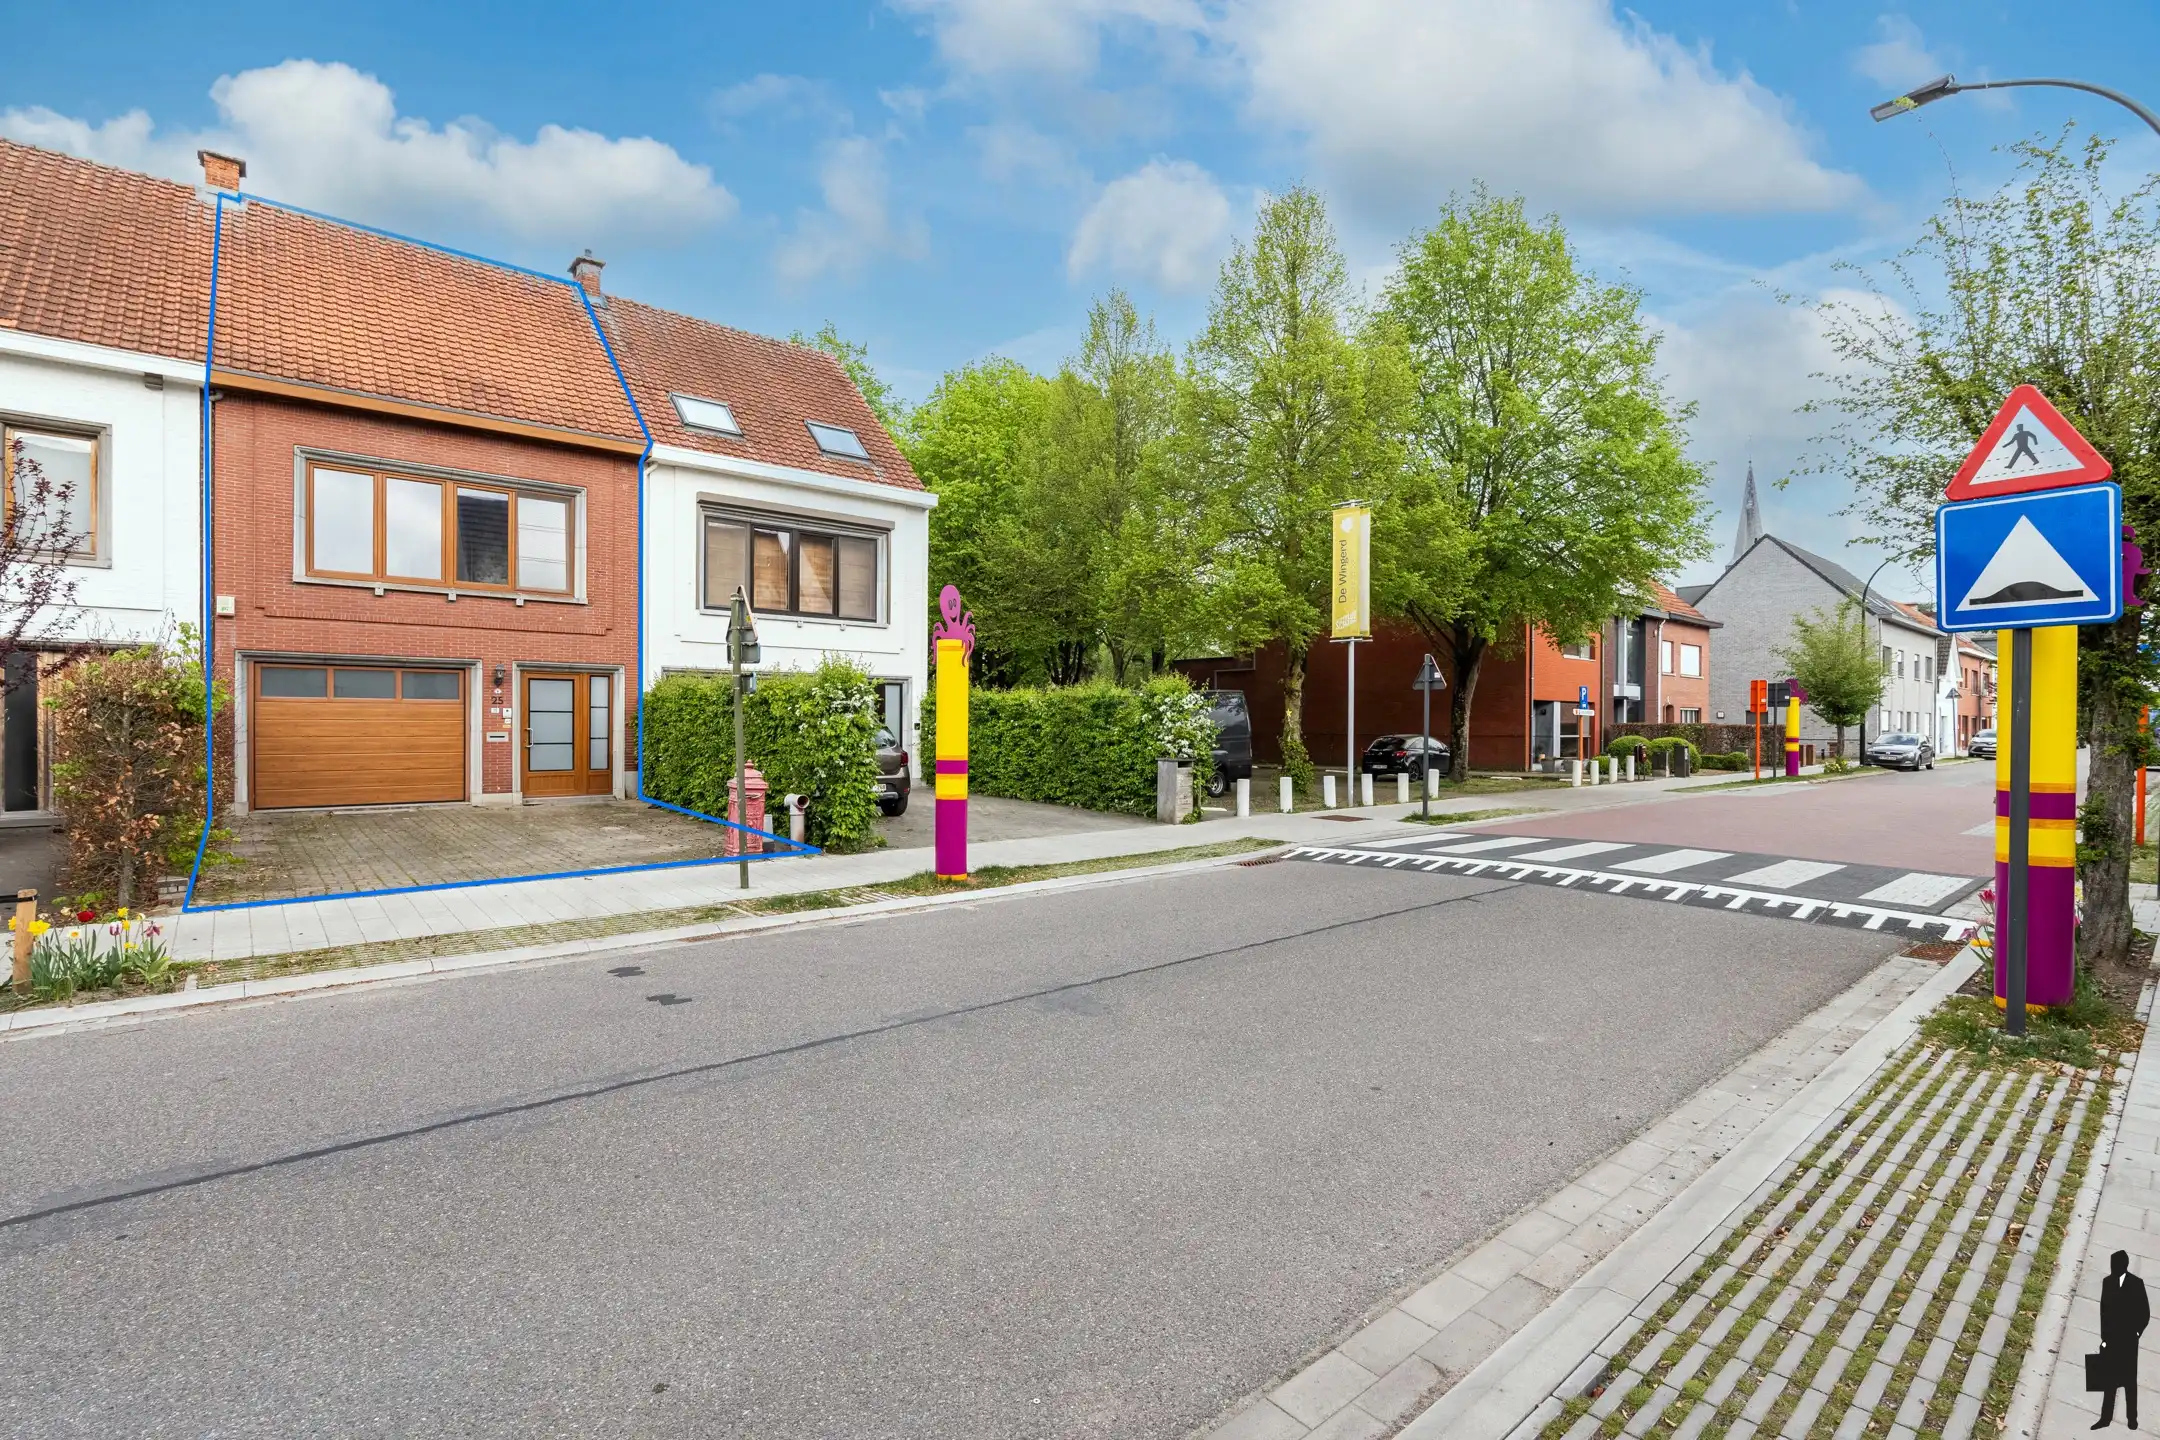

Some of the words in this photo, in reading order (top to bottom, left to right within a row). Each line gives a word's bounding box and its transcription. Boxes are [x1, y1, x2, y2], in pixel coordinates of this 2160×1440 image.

[1338, 539, 1348, 585] Wingerd
[1338, 588, 1347, 603] De
[491, 696, 504, 705] 25
[1581, 687, 1587, 700] P
